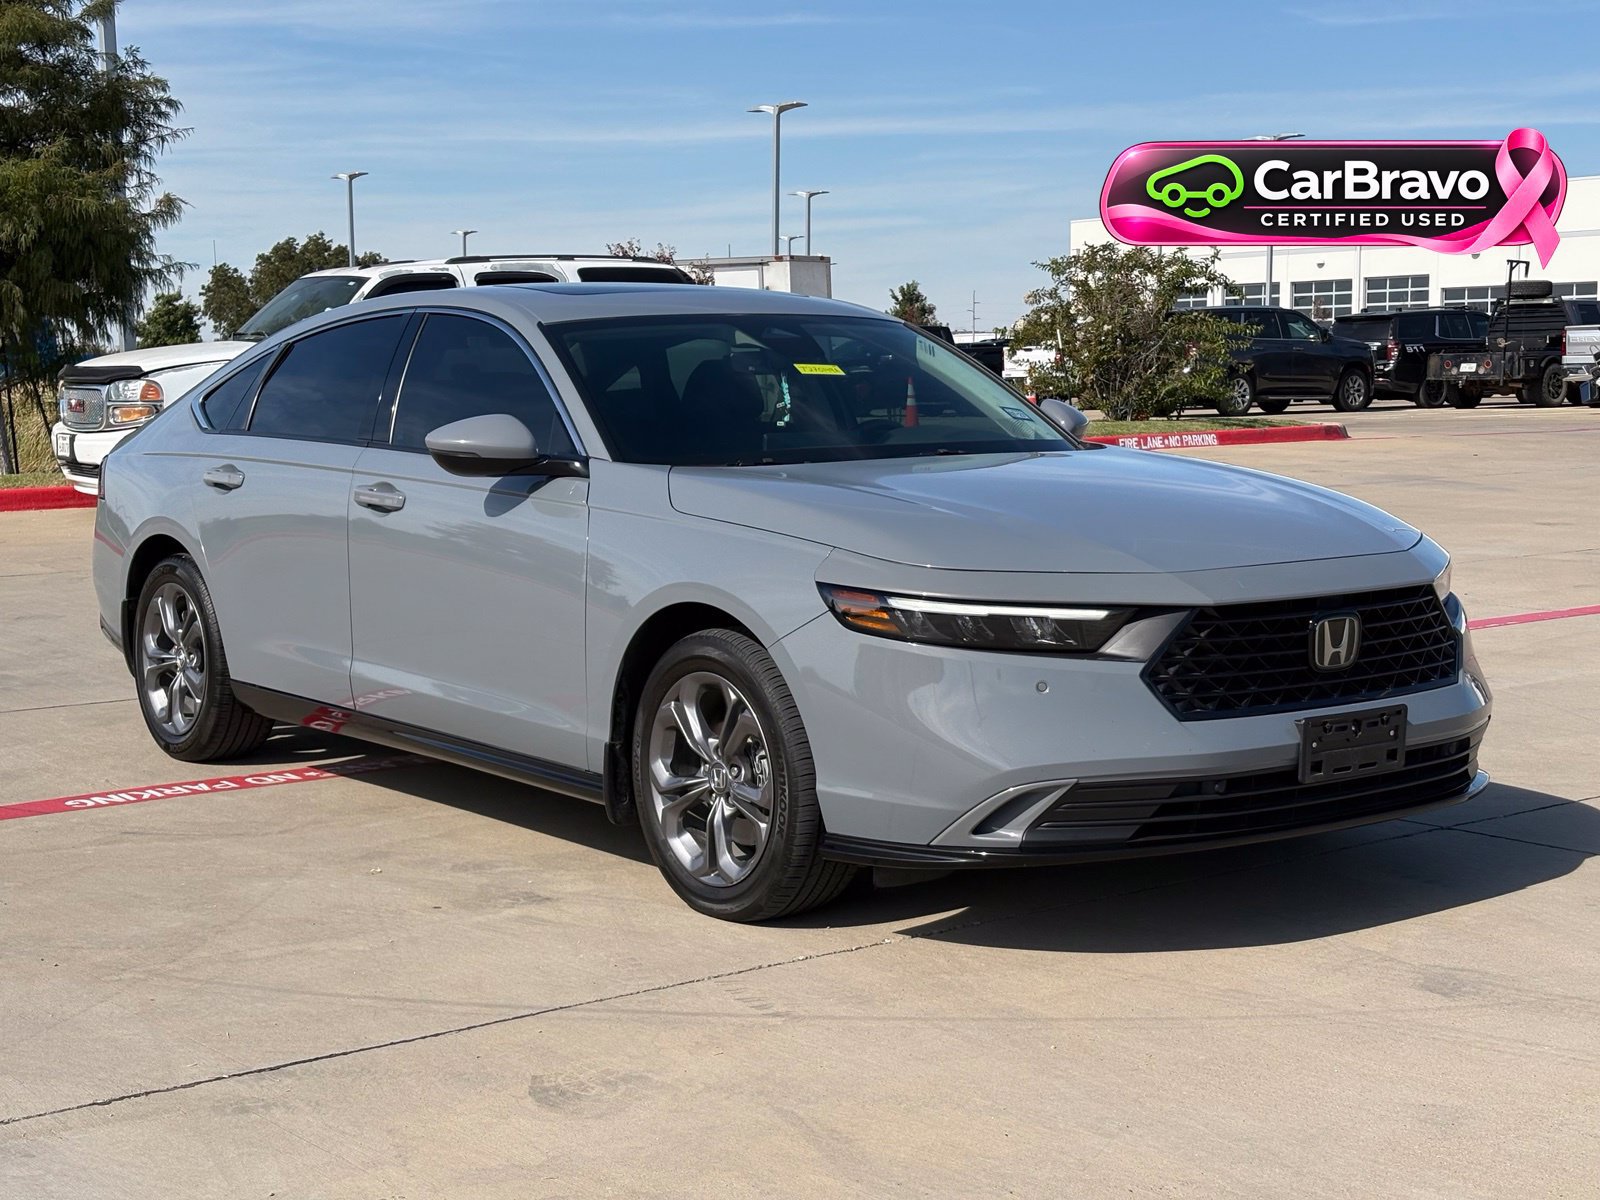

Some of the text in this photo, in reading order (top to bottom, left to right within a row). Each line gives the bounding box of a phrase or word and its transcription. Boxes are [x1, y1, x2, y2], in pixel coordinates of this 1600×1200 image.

[1118, 434, 1218, 449] FIRE LANE NO PARKING
[65, 772, 302, 808] NO PARKING
